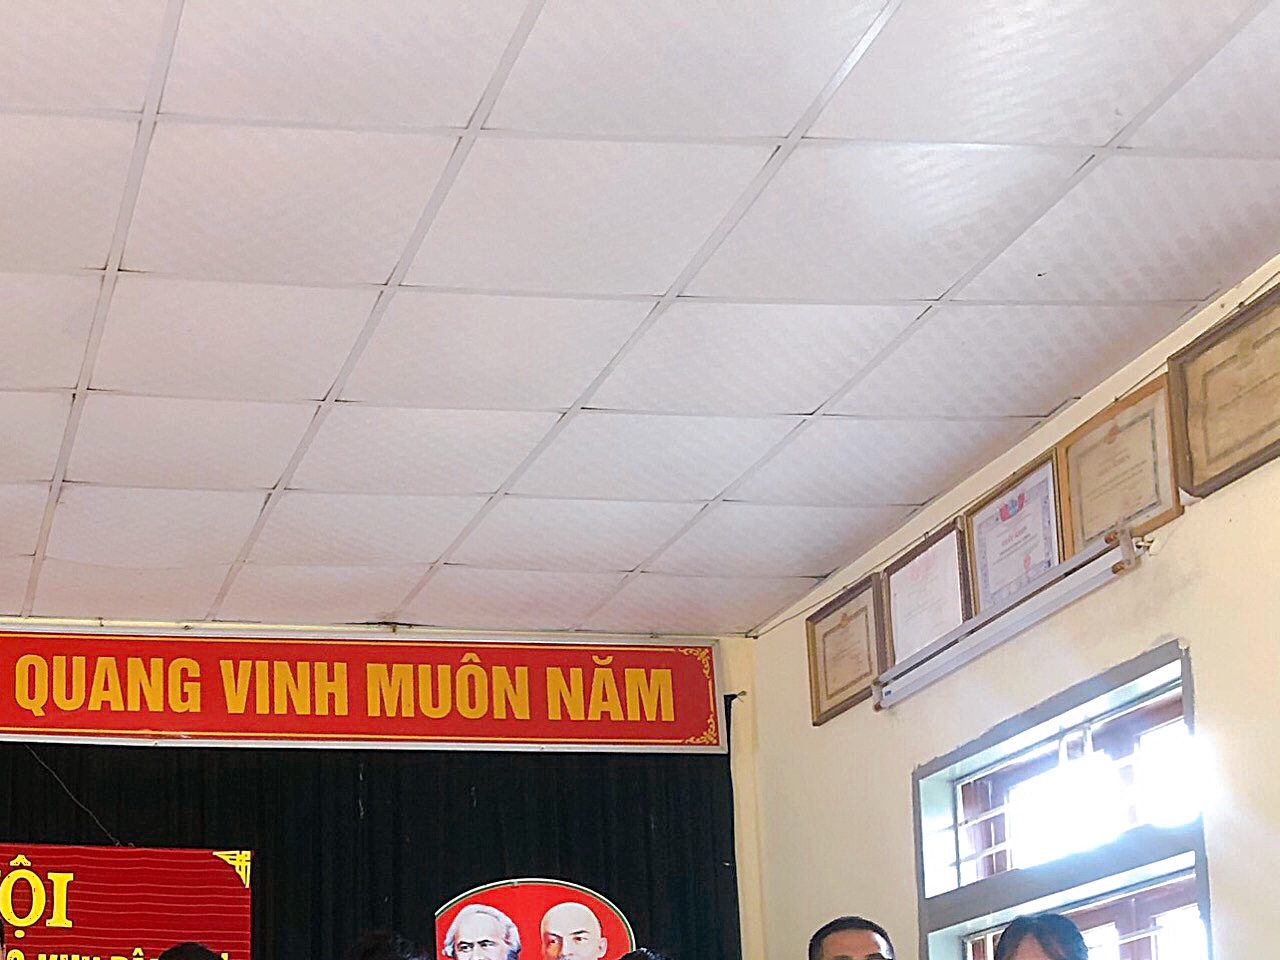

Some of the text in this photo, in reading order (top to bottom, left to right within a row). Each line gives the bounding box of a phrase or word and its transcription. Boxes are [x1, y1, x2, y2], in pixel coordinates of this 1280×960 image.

[15, 654, 201, 717] QUANG
[220, 659, 348, 716] VINH
[367, 653, 530, 720] MUÔN
[547, 655, 675, 722] NĂM
